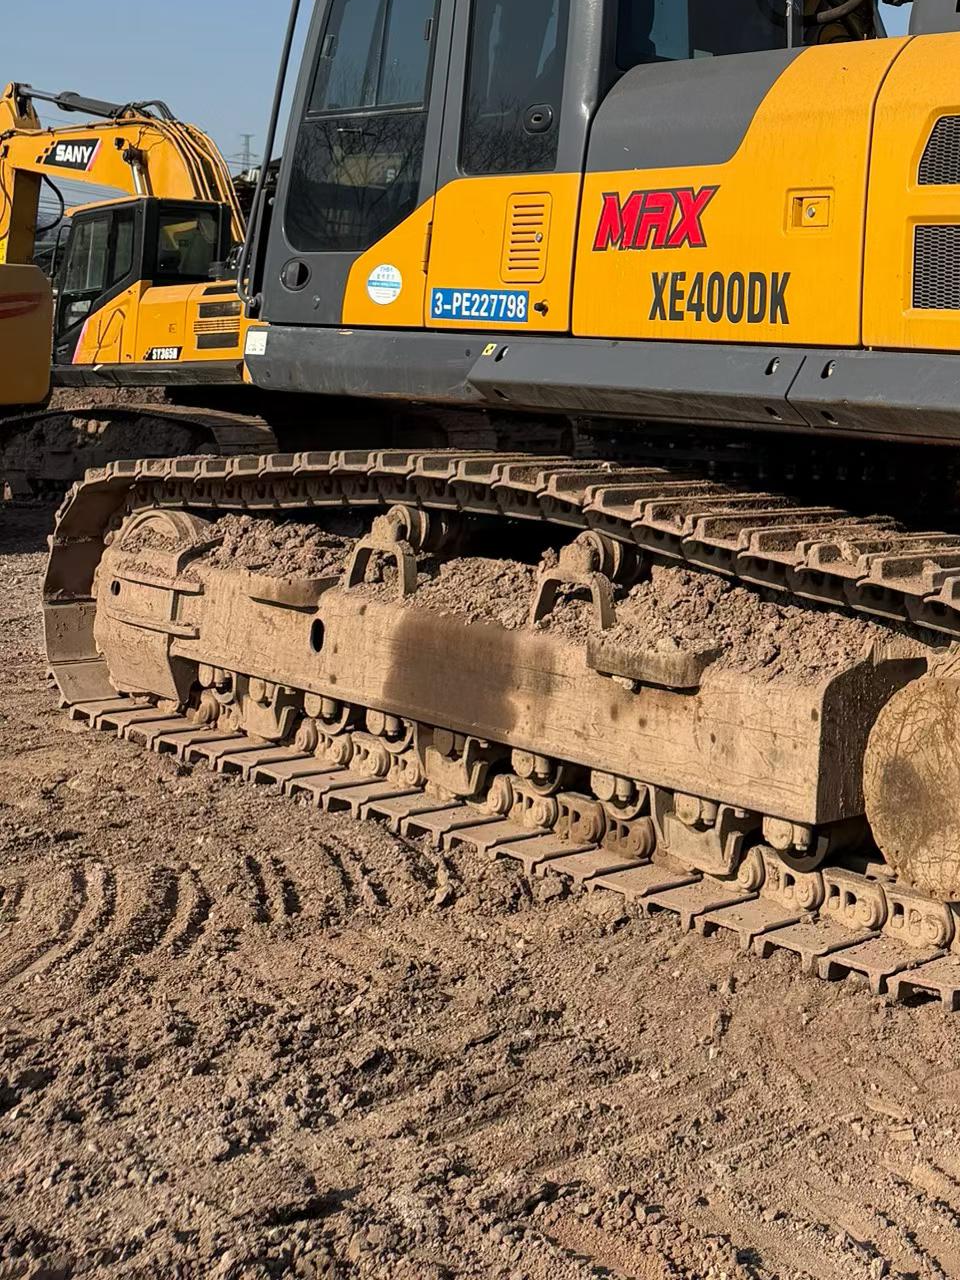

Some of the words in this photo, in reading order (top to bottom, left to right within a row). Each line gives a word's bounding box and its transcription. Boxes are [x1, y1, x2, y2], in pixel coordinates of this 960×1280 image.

[55, 144, 93, 164] SANY
[592, 184, 721, 252] MAX
[434, 291, 527, 319] 3-PE227798
[648, 271, 791, 325] XE400DK
